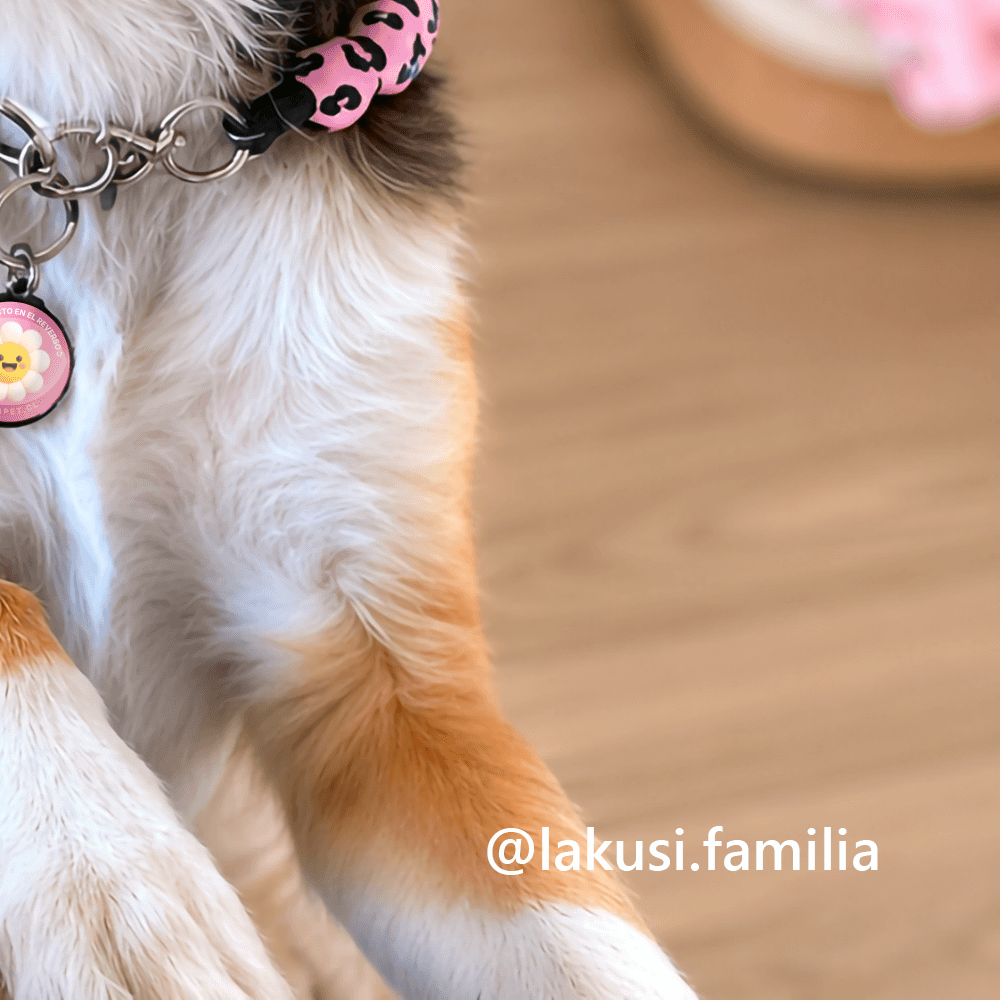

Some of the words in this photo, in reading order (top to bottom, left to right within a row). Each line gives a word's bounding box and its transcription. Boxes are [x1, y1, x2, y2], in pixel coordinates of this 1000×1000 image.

[14, 308, 27, 317] EN
[26, 311, 36, 321] EL
[36, 317, 62, 350] REVERSO
